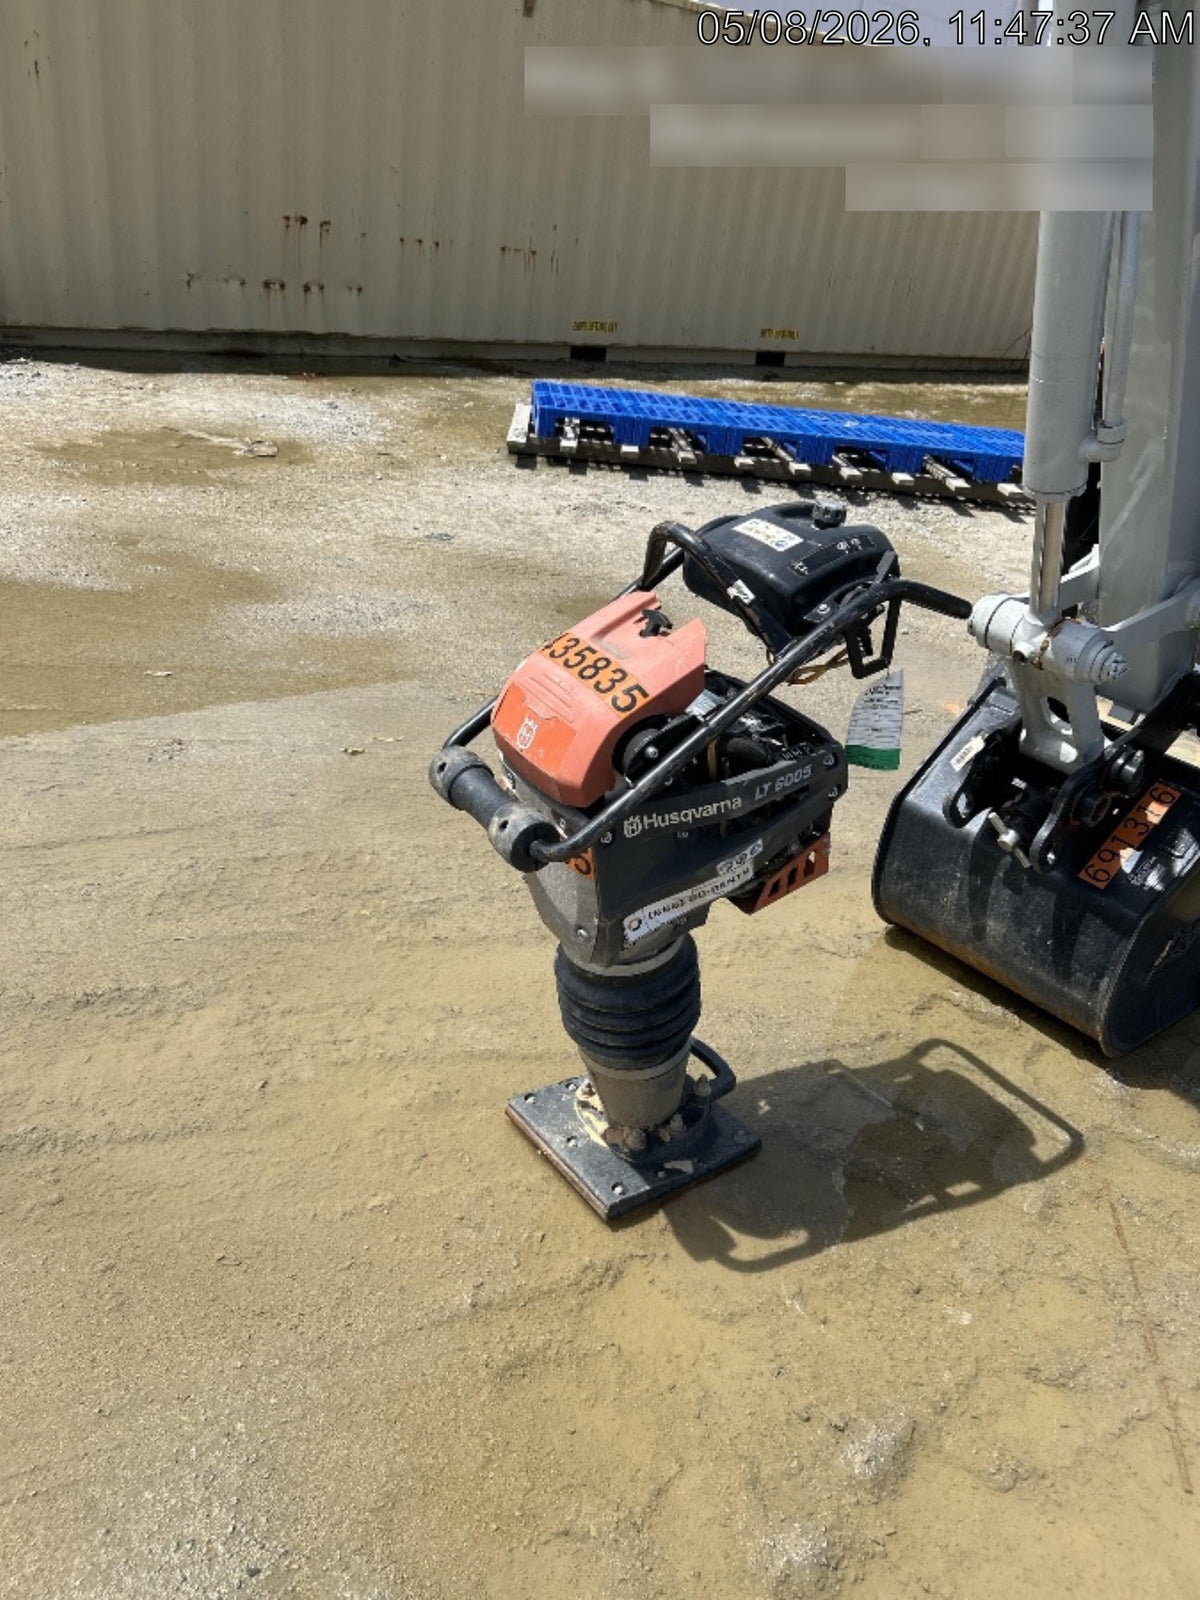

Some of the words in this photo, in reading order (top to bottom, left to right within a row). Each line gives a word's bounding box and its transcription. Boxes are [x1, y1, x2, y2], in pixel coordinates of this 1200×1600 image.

[643, 796, 742, 830] Husqvarna
[754, 781, 774, 801] LT
[1085, 786, 1176, 883] 691316
